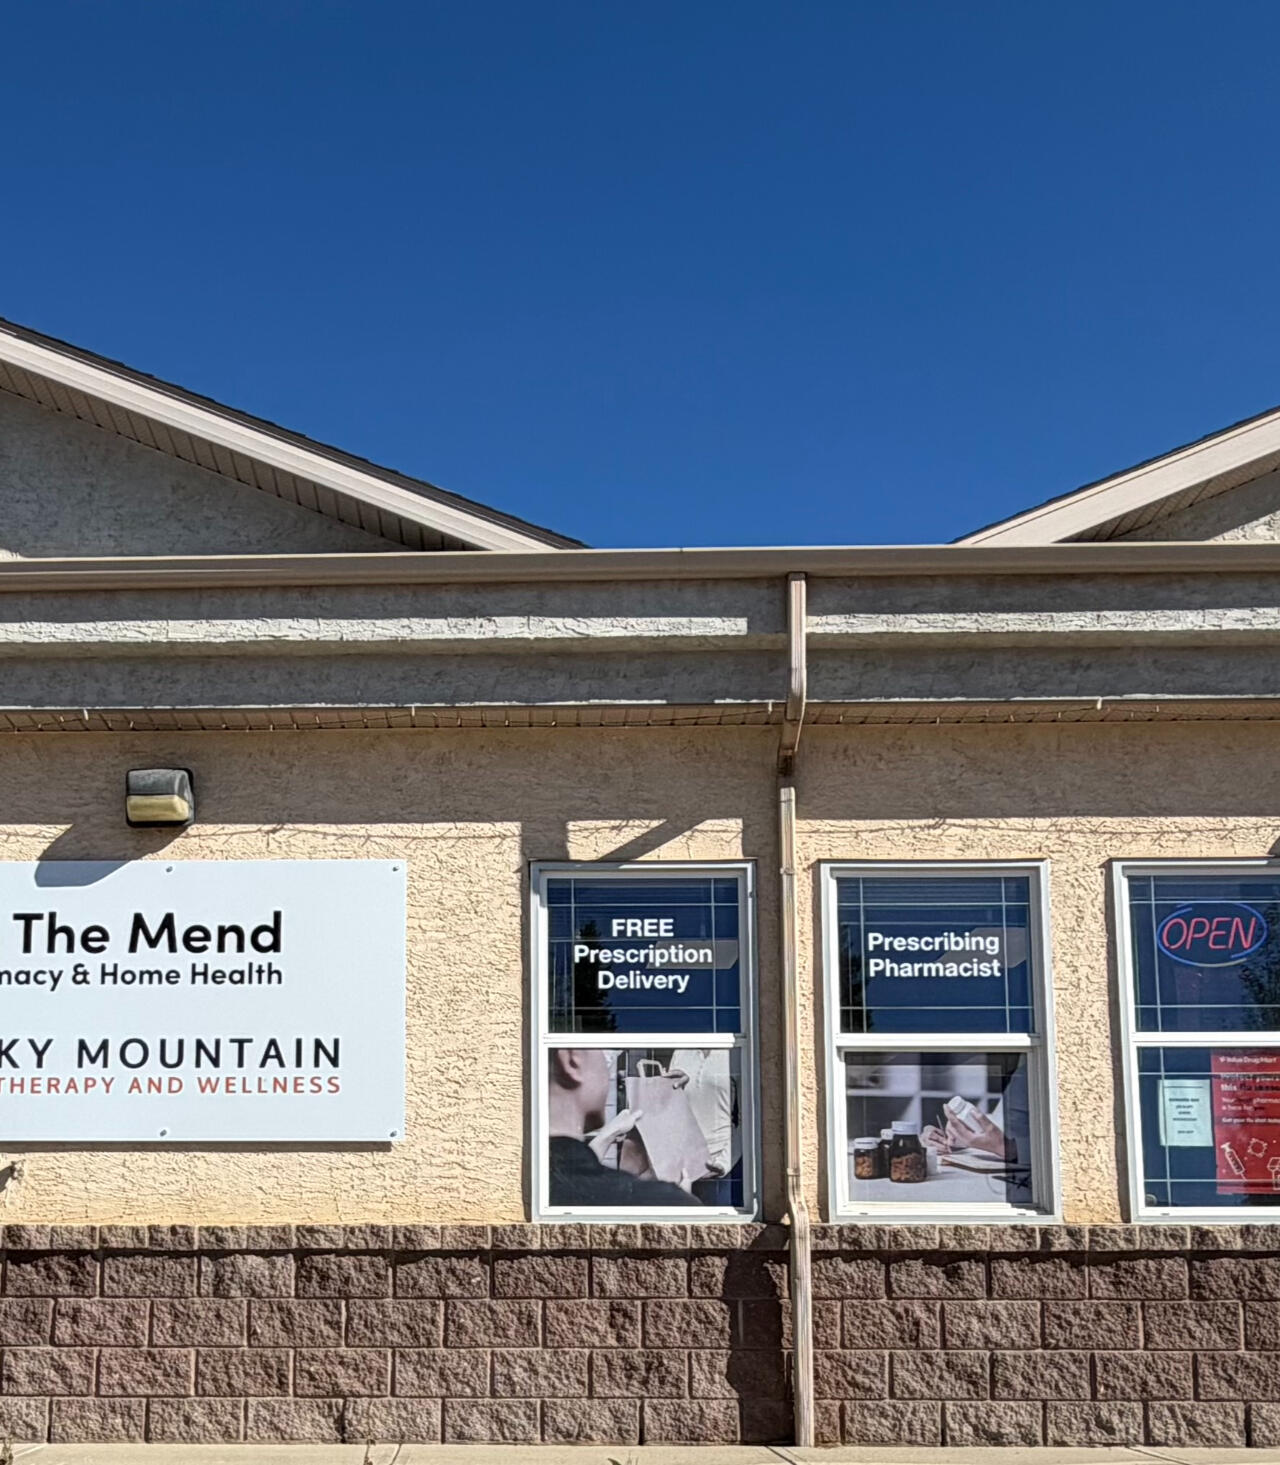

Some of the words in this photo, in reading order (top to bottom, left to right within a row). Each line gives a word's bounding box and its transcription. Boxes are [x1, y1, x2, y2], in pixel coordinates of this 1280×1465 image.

[13, 911, 110, 954] The
[128, 911, 282, 953] Mend
[612, 918, 675, 937] FREE
[1162, 917, 1257, 950] OPEN
[868, 932, 1000, 955] Prescribing
[573, 944, 713, 967] Prescription
[72, 963, 90, 985] &
[100, 963, 181, 985] Home
[191, 962, 283, 985] Health
[869, 958, 1002, 978] Pharmacist
[598, 970, 690, 994] Delivery
[76, 1037, 341, 1069] MOUNTAIN
[127, 1076, 184, 1094] AND
[197, 1076, 341, 1094] WELLNESS
